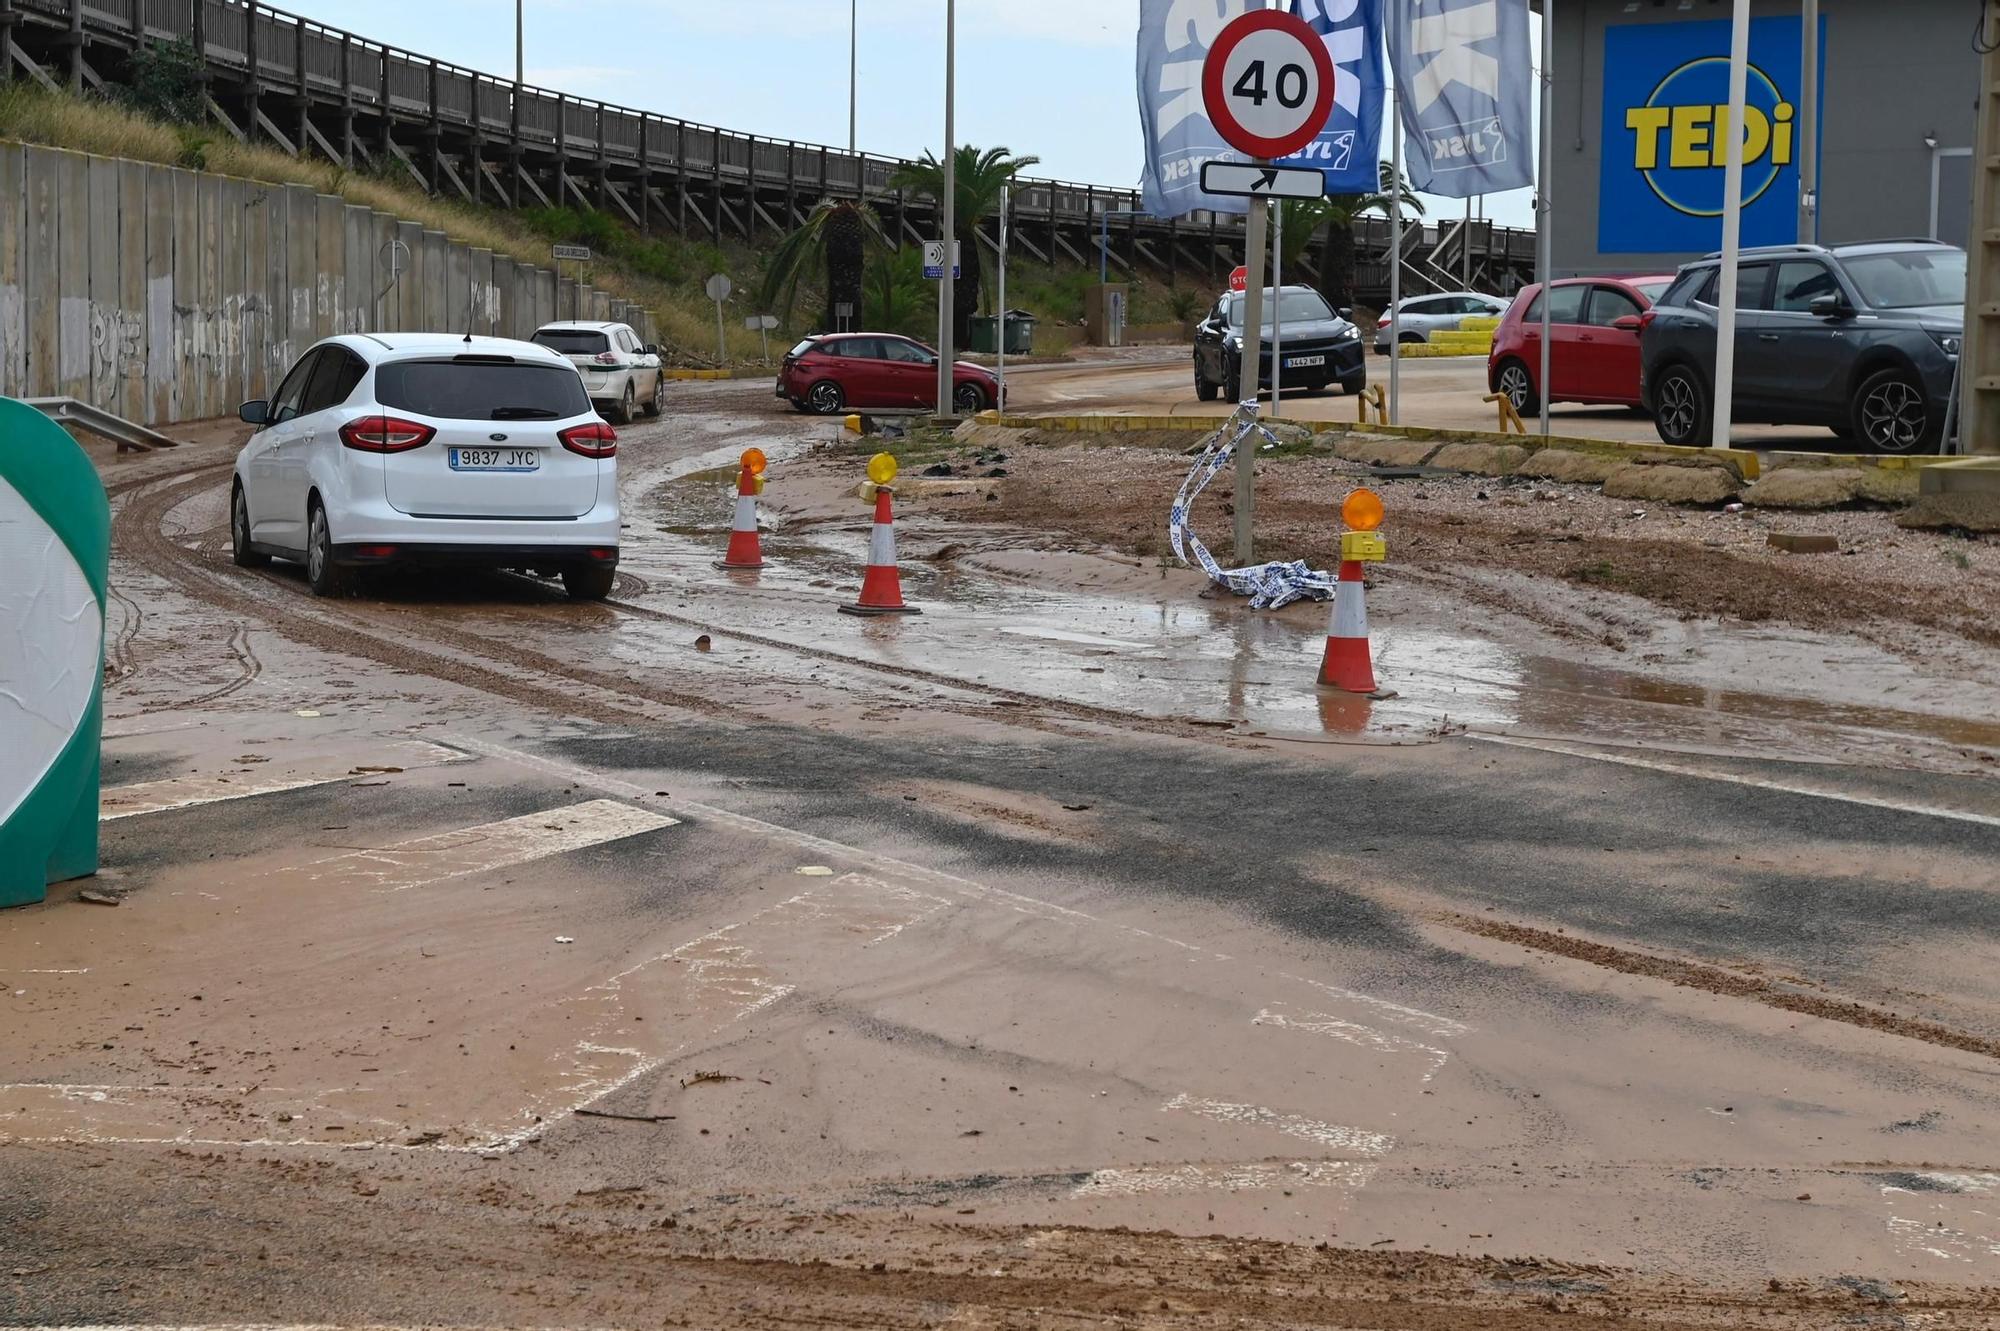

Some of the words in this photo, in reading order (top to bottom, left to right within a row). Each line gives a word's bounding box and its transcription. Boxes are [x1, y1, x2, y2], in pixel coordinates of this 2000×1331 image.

[1232, 60, 1308, 109] 40
[1625, 102, 1794, 169] TEDi
[461, 451, 499, 465] 9837
[506, 451, 535, 466] JYC
